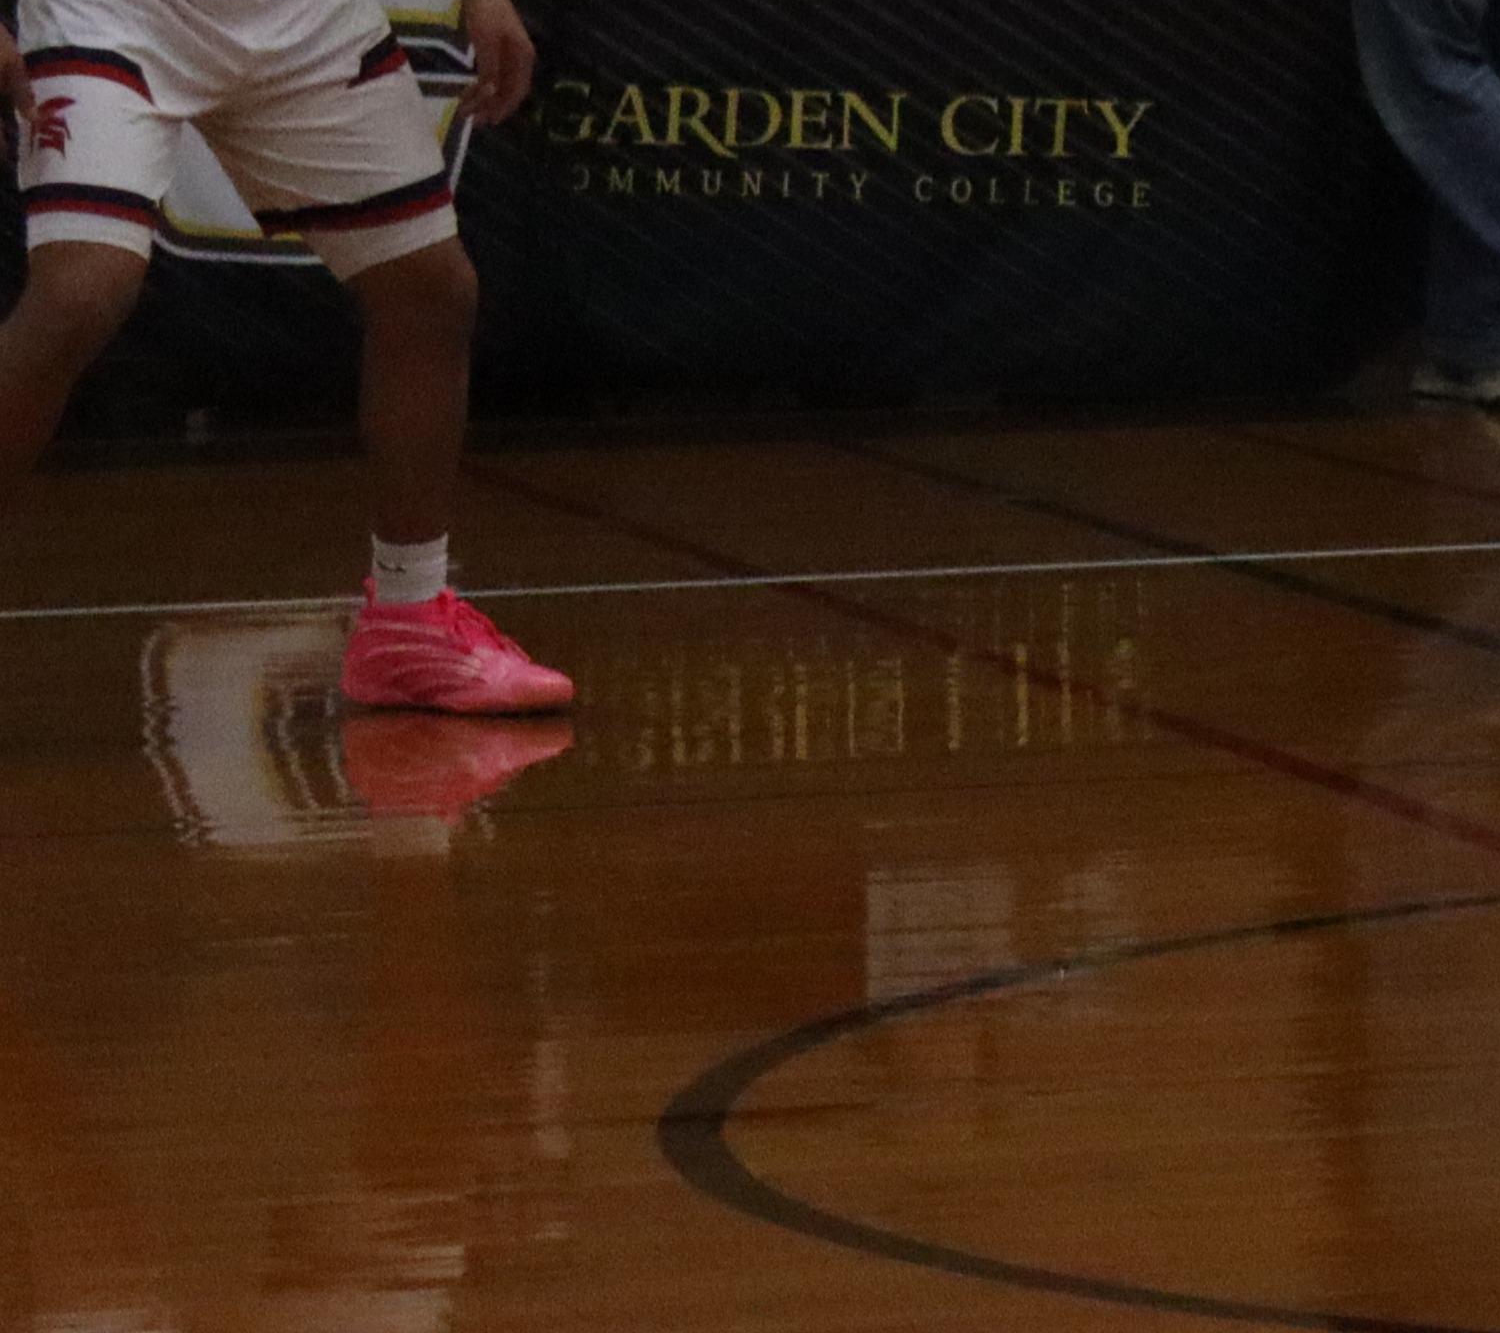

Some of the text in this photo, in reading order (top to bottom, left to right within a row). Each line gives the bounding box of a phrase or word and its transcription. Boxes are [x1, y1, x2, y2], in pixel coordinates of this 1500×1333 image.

[533, 80, 1155, 160] GARDEN CITY
[572, 164, 1151, 209] OMMUNITY COLLEGE
